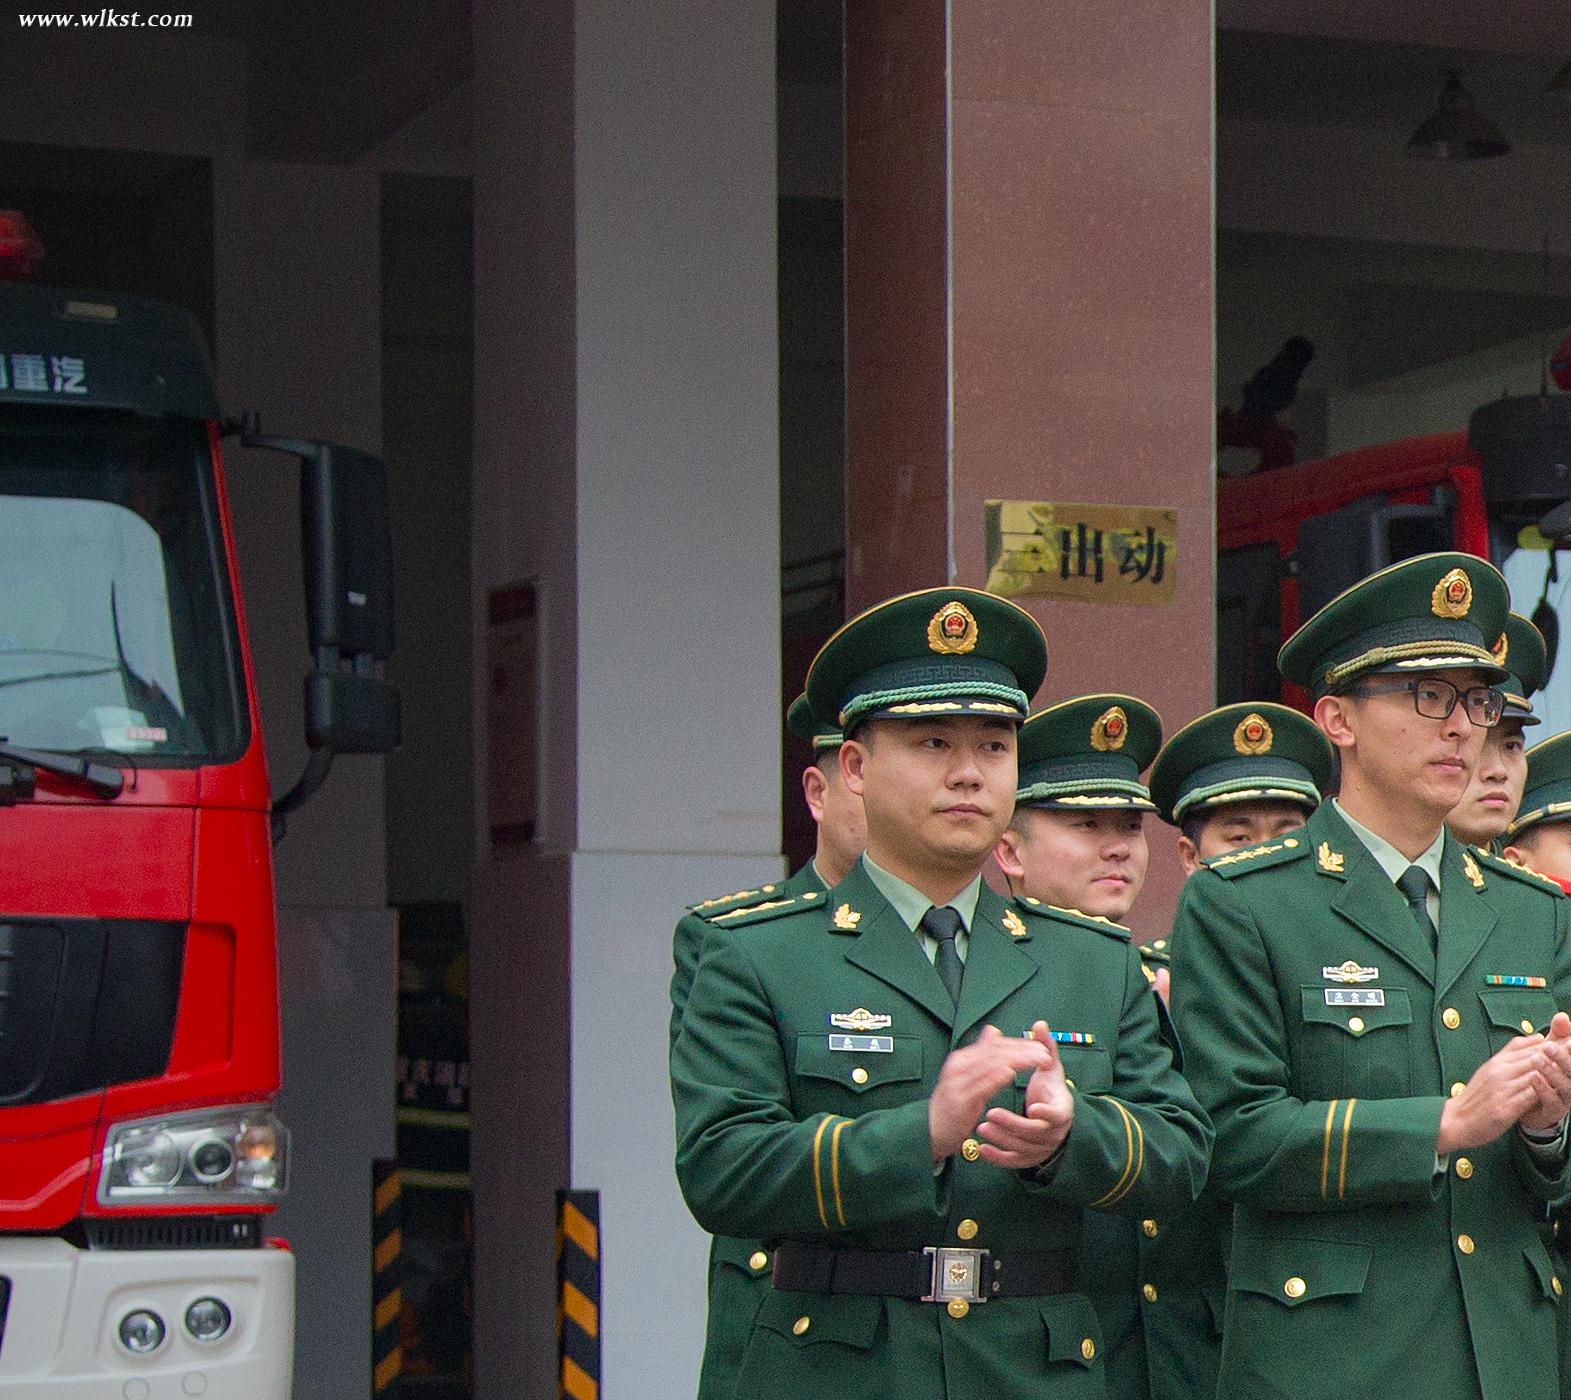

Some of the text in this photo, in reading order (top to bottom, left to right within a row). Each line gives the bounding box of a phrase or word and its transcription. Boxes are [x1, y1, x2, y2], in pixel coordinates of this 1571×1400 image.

[0, 353, 88, 393] 重汽
[998, 521, 1168, 585] 三出动
